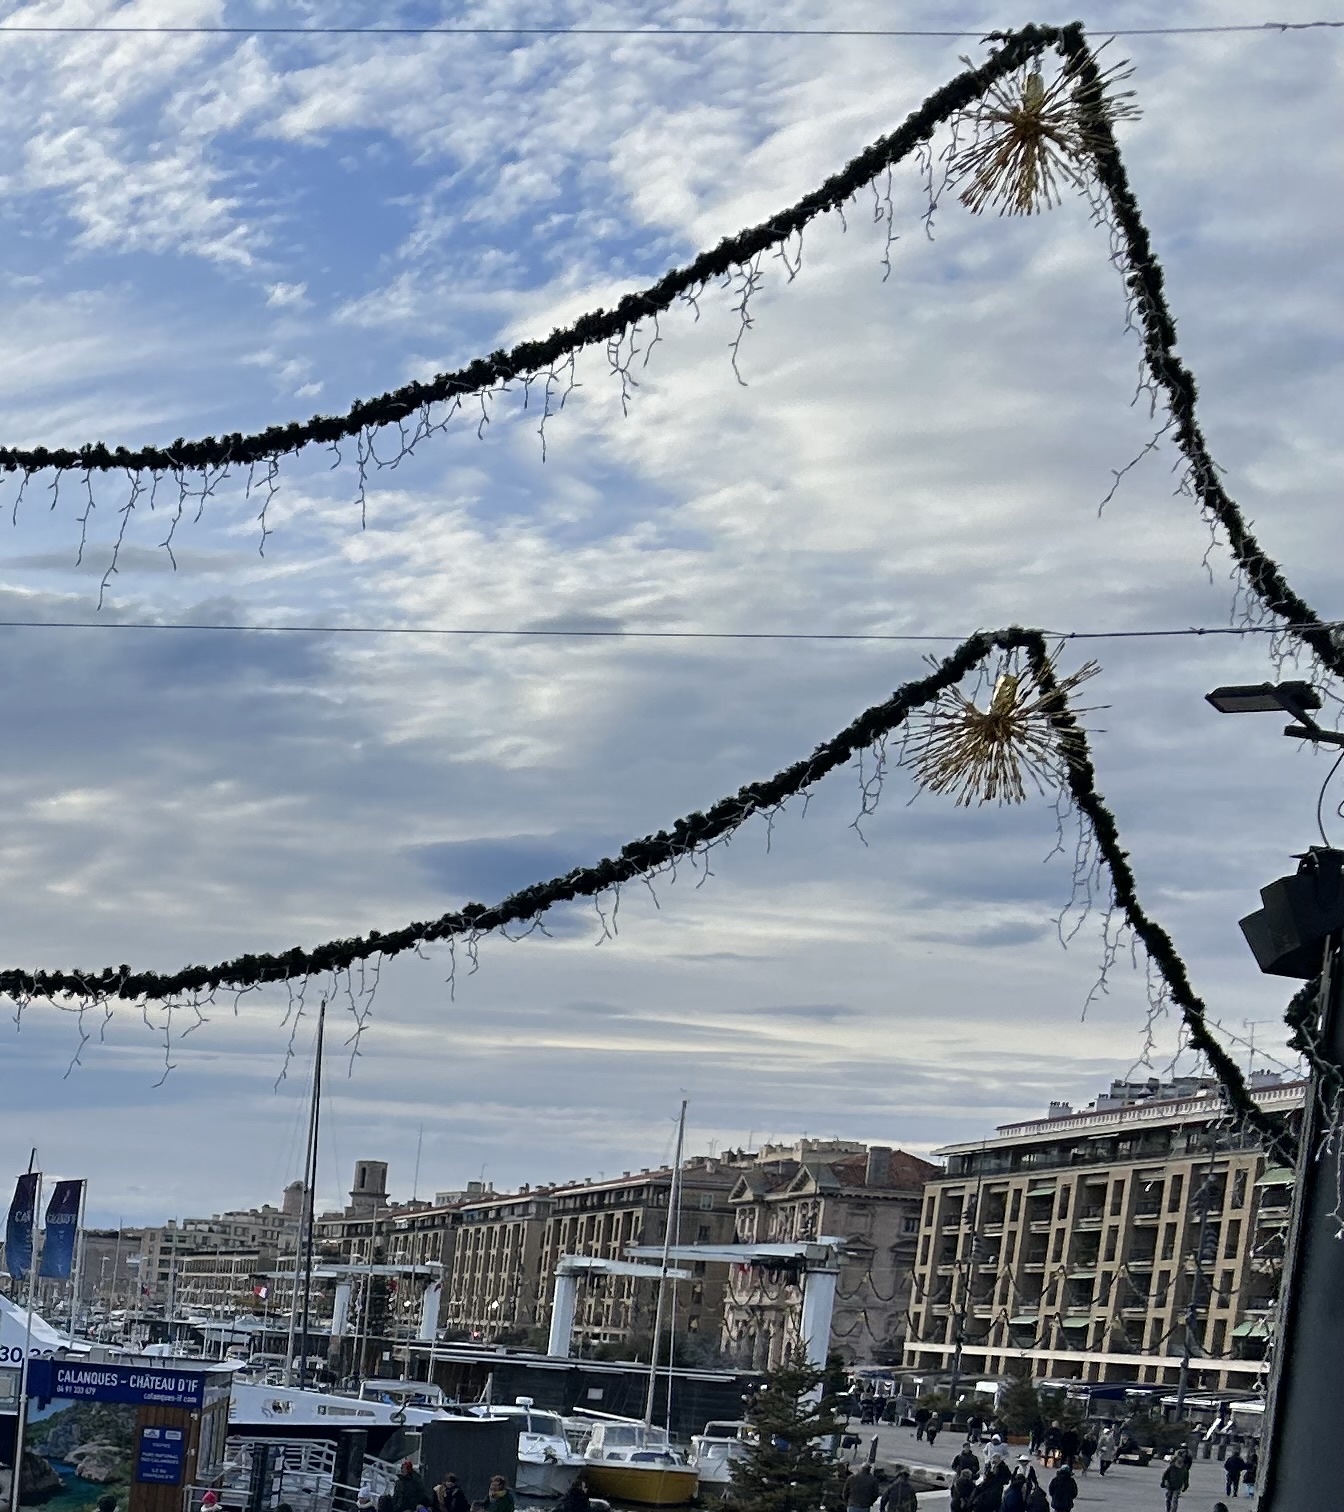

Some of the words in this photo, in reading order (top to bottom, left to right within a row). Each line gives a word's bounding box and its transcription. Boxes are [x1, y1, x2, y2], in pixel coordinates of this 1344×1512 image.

[57, 1369, 119, 1387] CALANQUES
[129, 1373, 176, 1391] CHÂTEAU
[177, 1378, 199, 1393] D'IF
